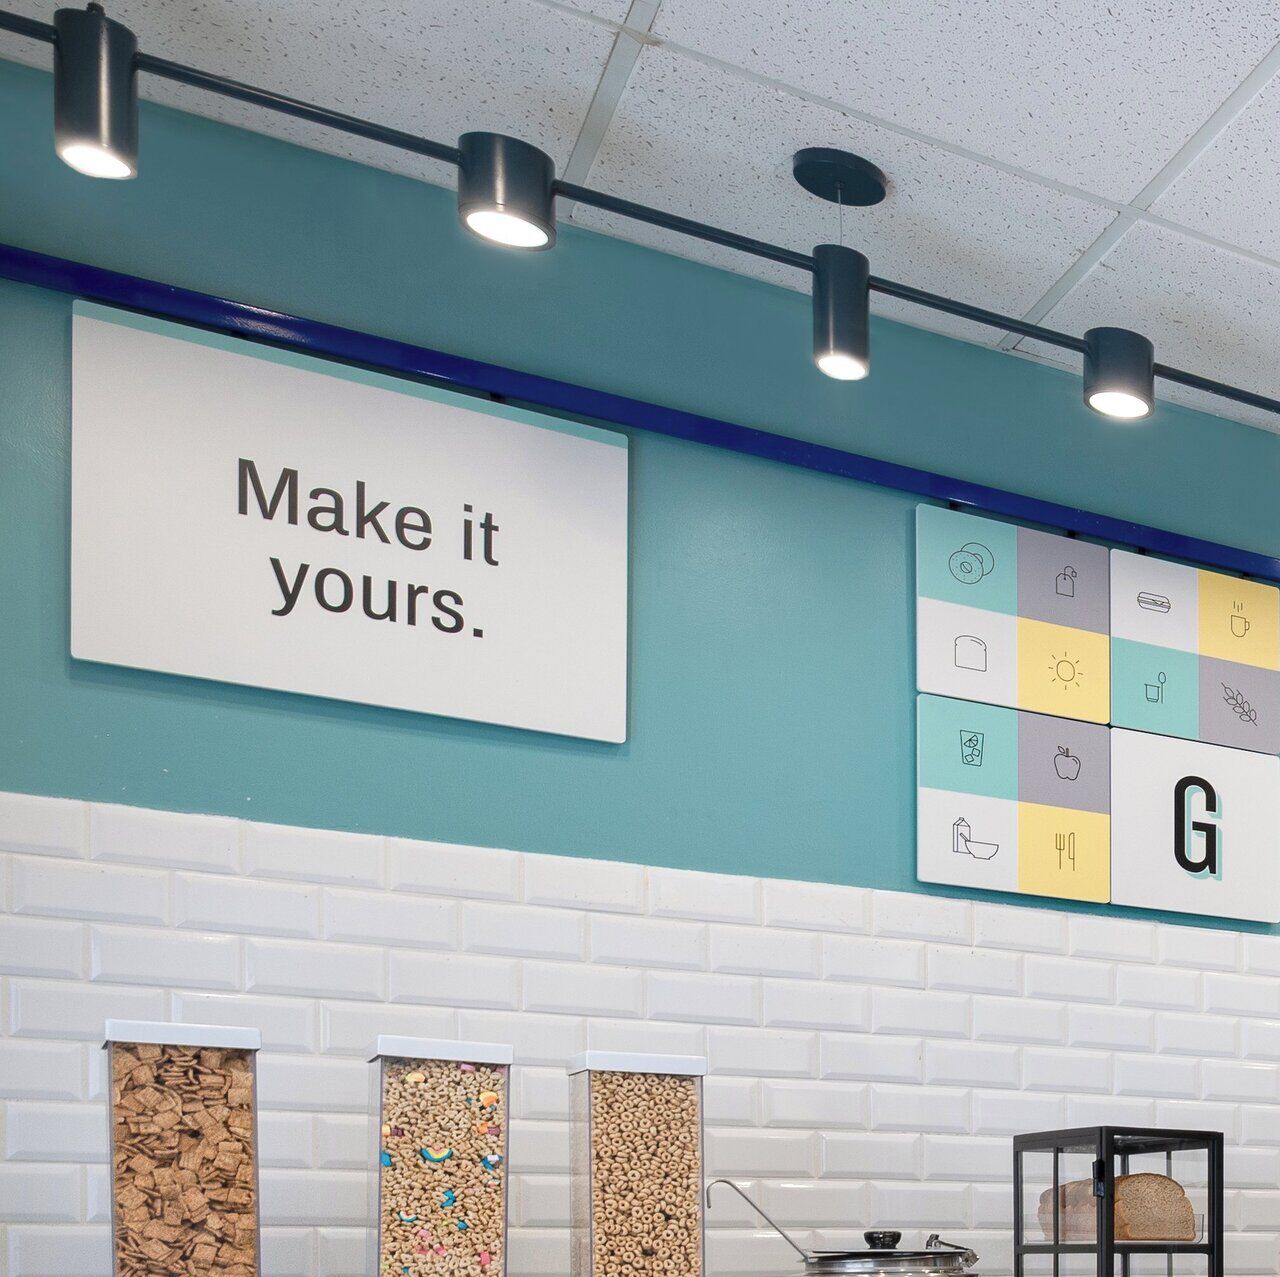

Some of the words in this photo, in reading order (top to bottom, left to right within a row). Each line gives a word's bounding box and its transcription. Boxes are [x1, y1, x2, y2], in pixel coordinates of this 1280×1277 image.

[237, 457, 432, 551] Make
[463, 503, 499, 567] it
[269, 556, 485, 639] yours.
[1173, 774, 1220, 878] G
